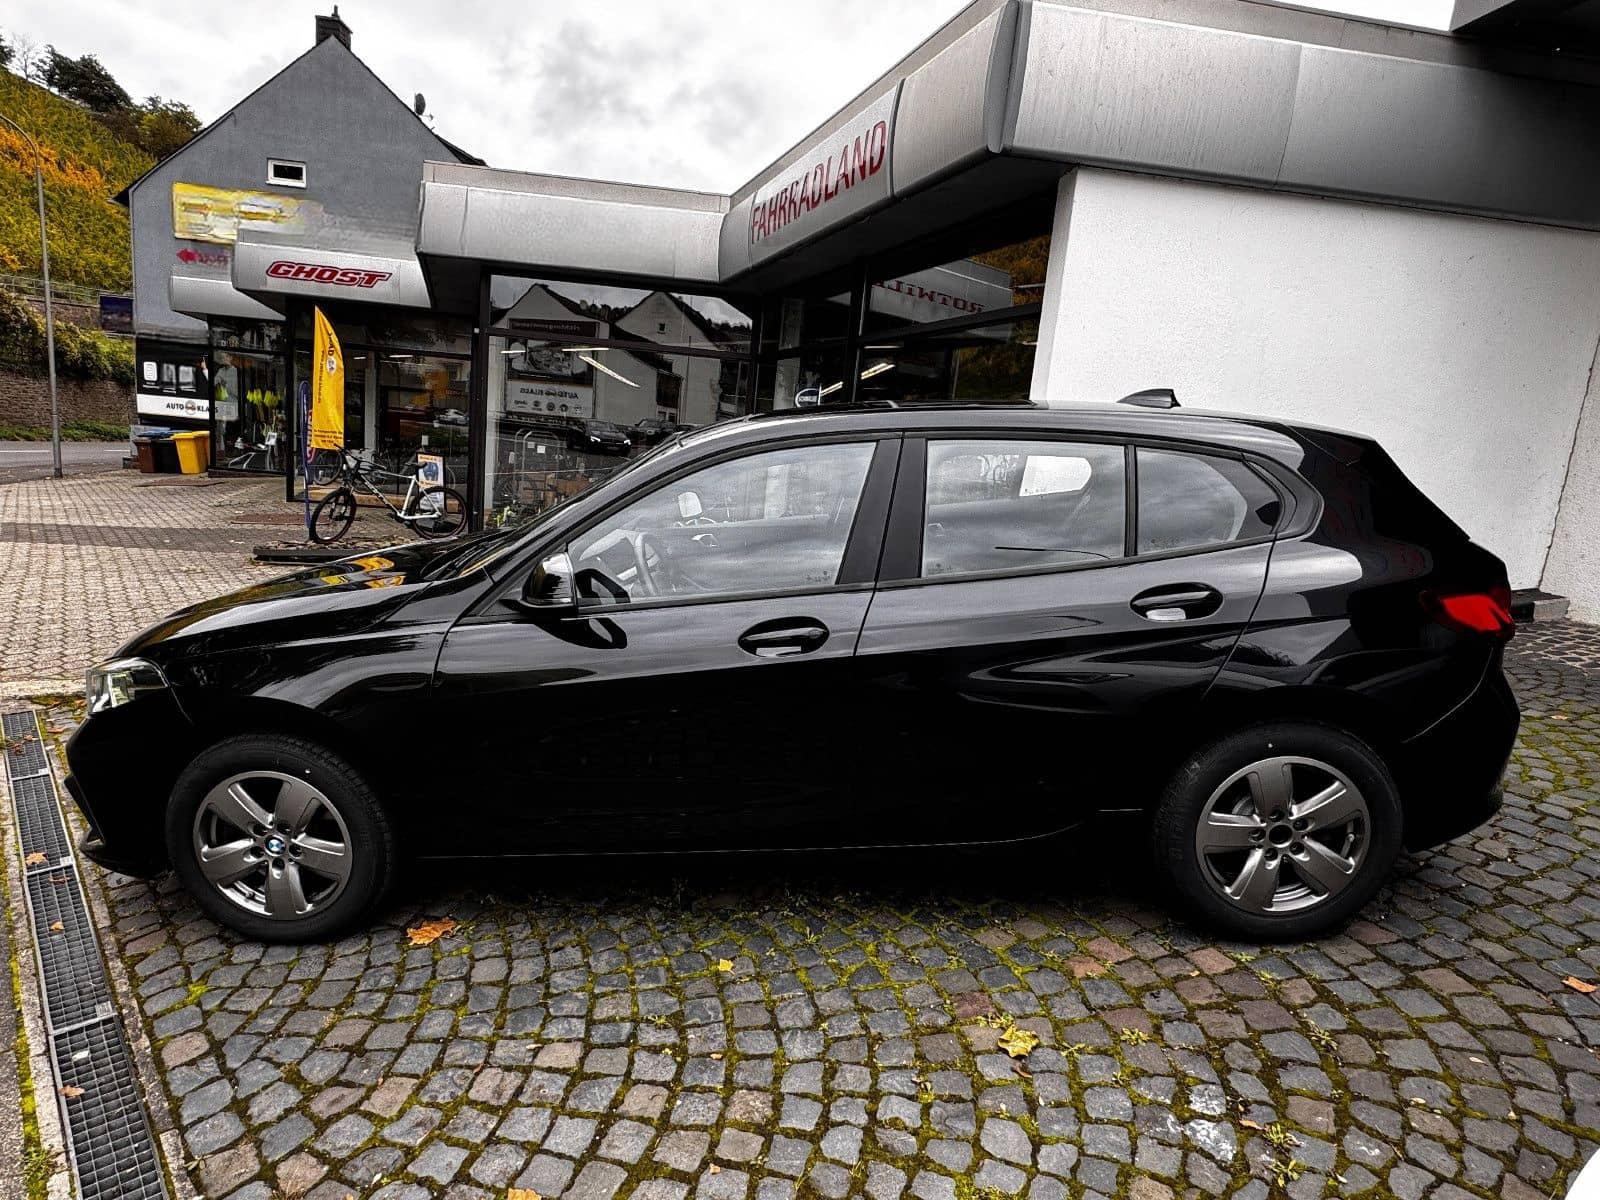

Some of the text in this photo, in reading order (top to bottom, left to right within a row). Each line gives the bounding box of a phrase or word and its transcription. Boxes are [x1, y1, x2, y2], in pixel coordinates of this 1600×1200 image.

[751, 120, 887, 244] FAHRRADLAND
[266, 260, 392, 289] GHOST
[166, 402, 184, 411] AUTO
